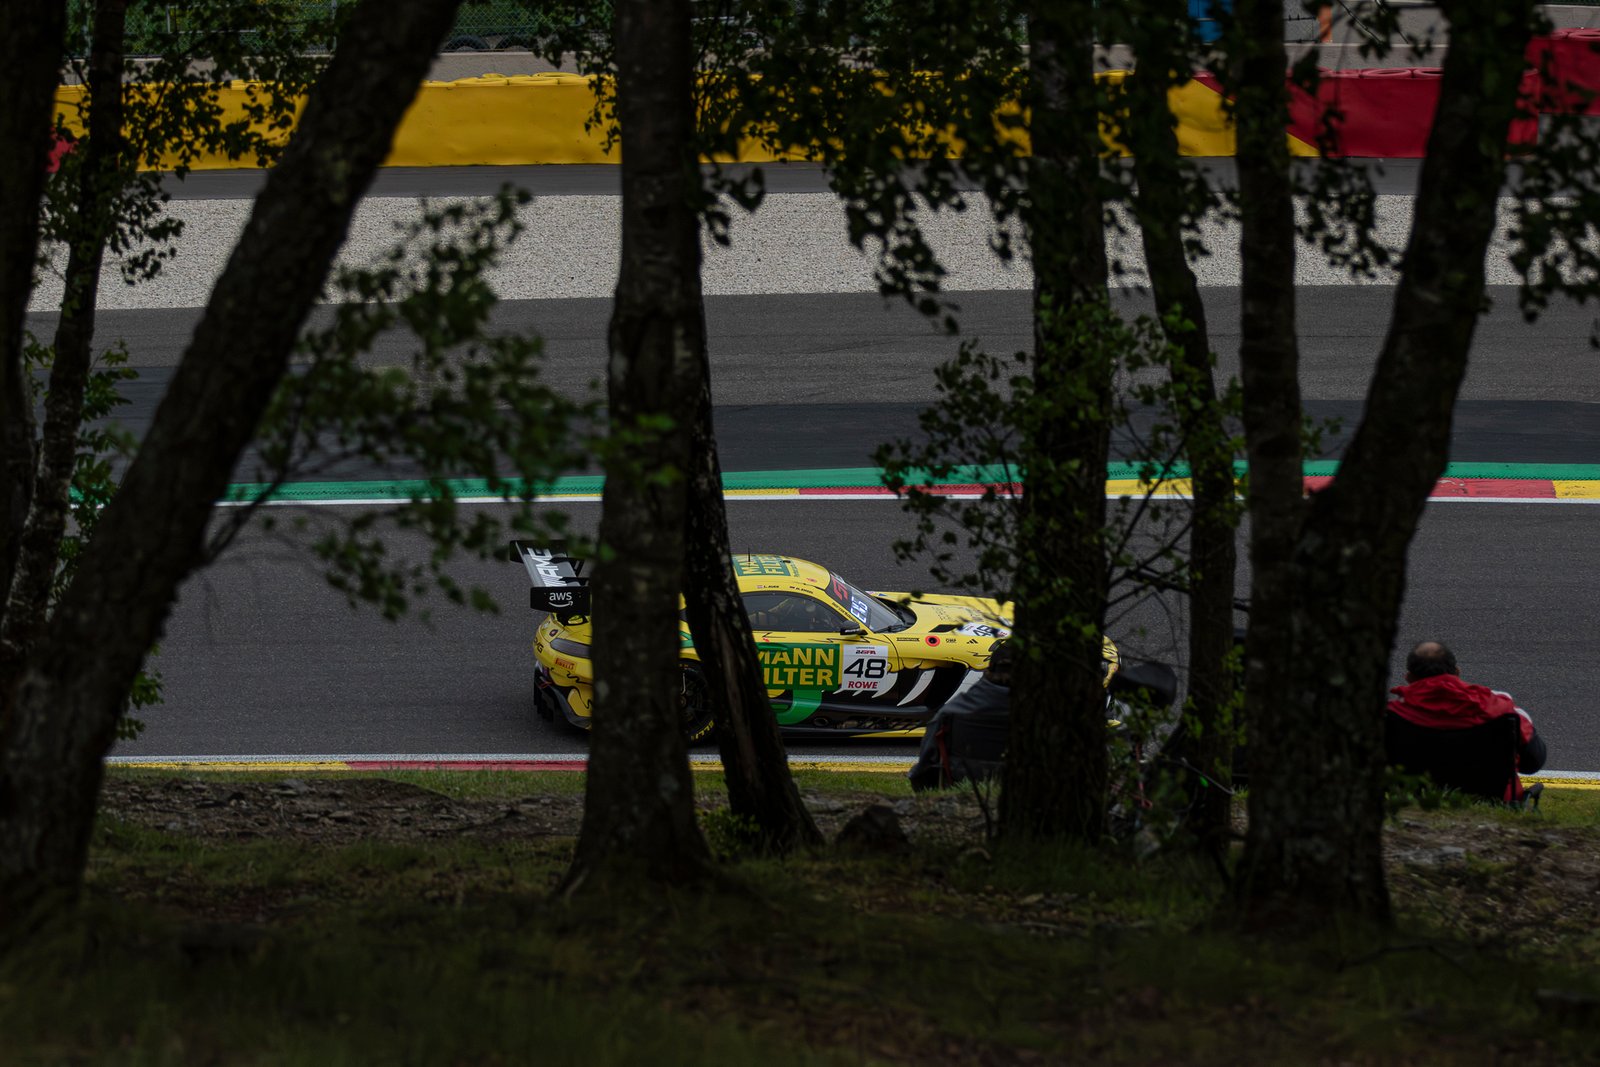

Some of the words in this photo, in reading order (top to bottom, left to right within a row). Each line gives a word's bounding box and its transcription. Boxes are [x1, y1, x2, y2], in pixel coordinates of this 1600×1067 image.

[549, 592, 572, 601] aws
[843, 658, 886, 679] 48
[763, 667, 833, 686] ILTER
[847, 681, 878, 689] ROWE
